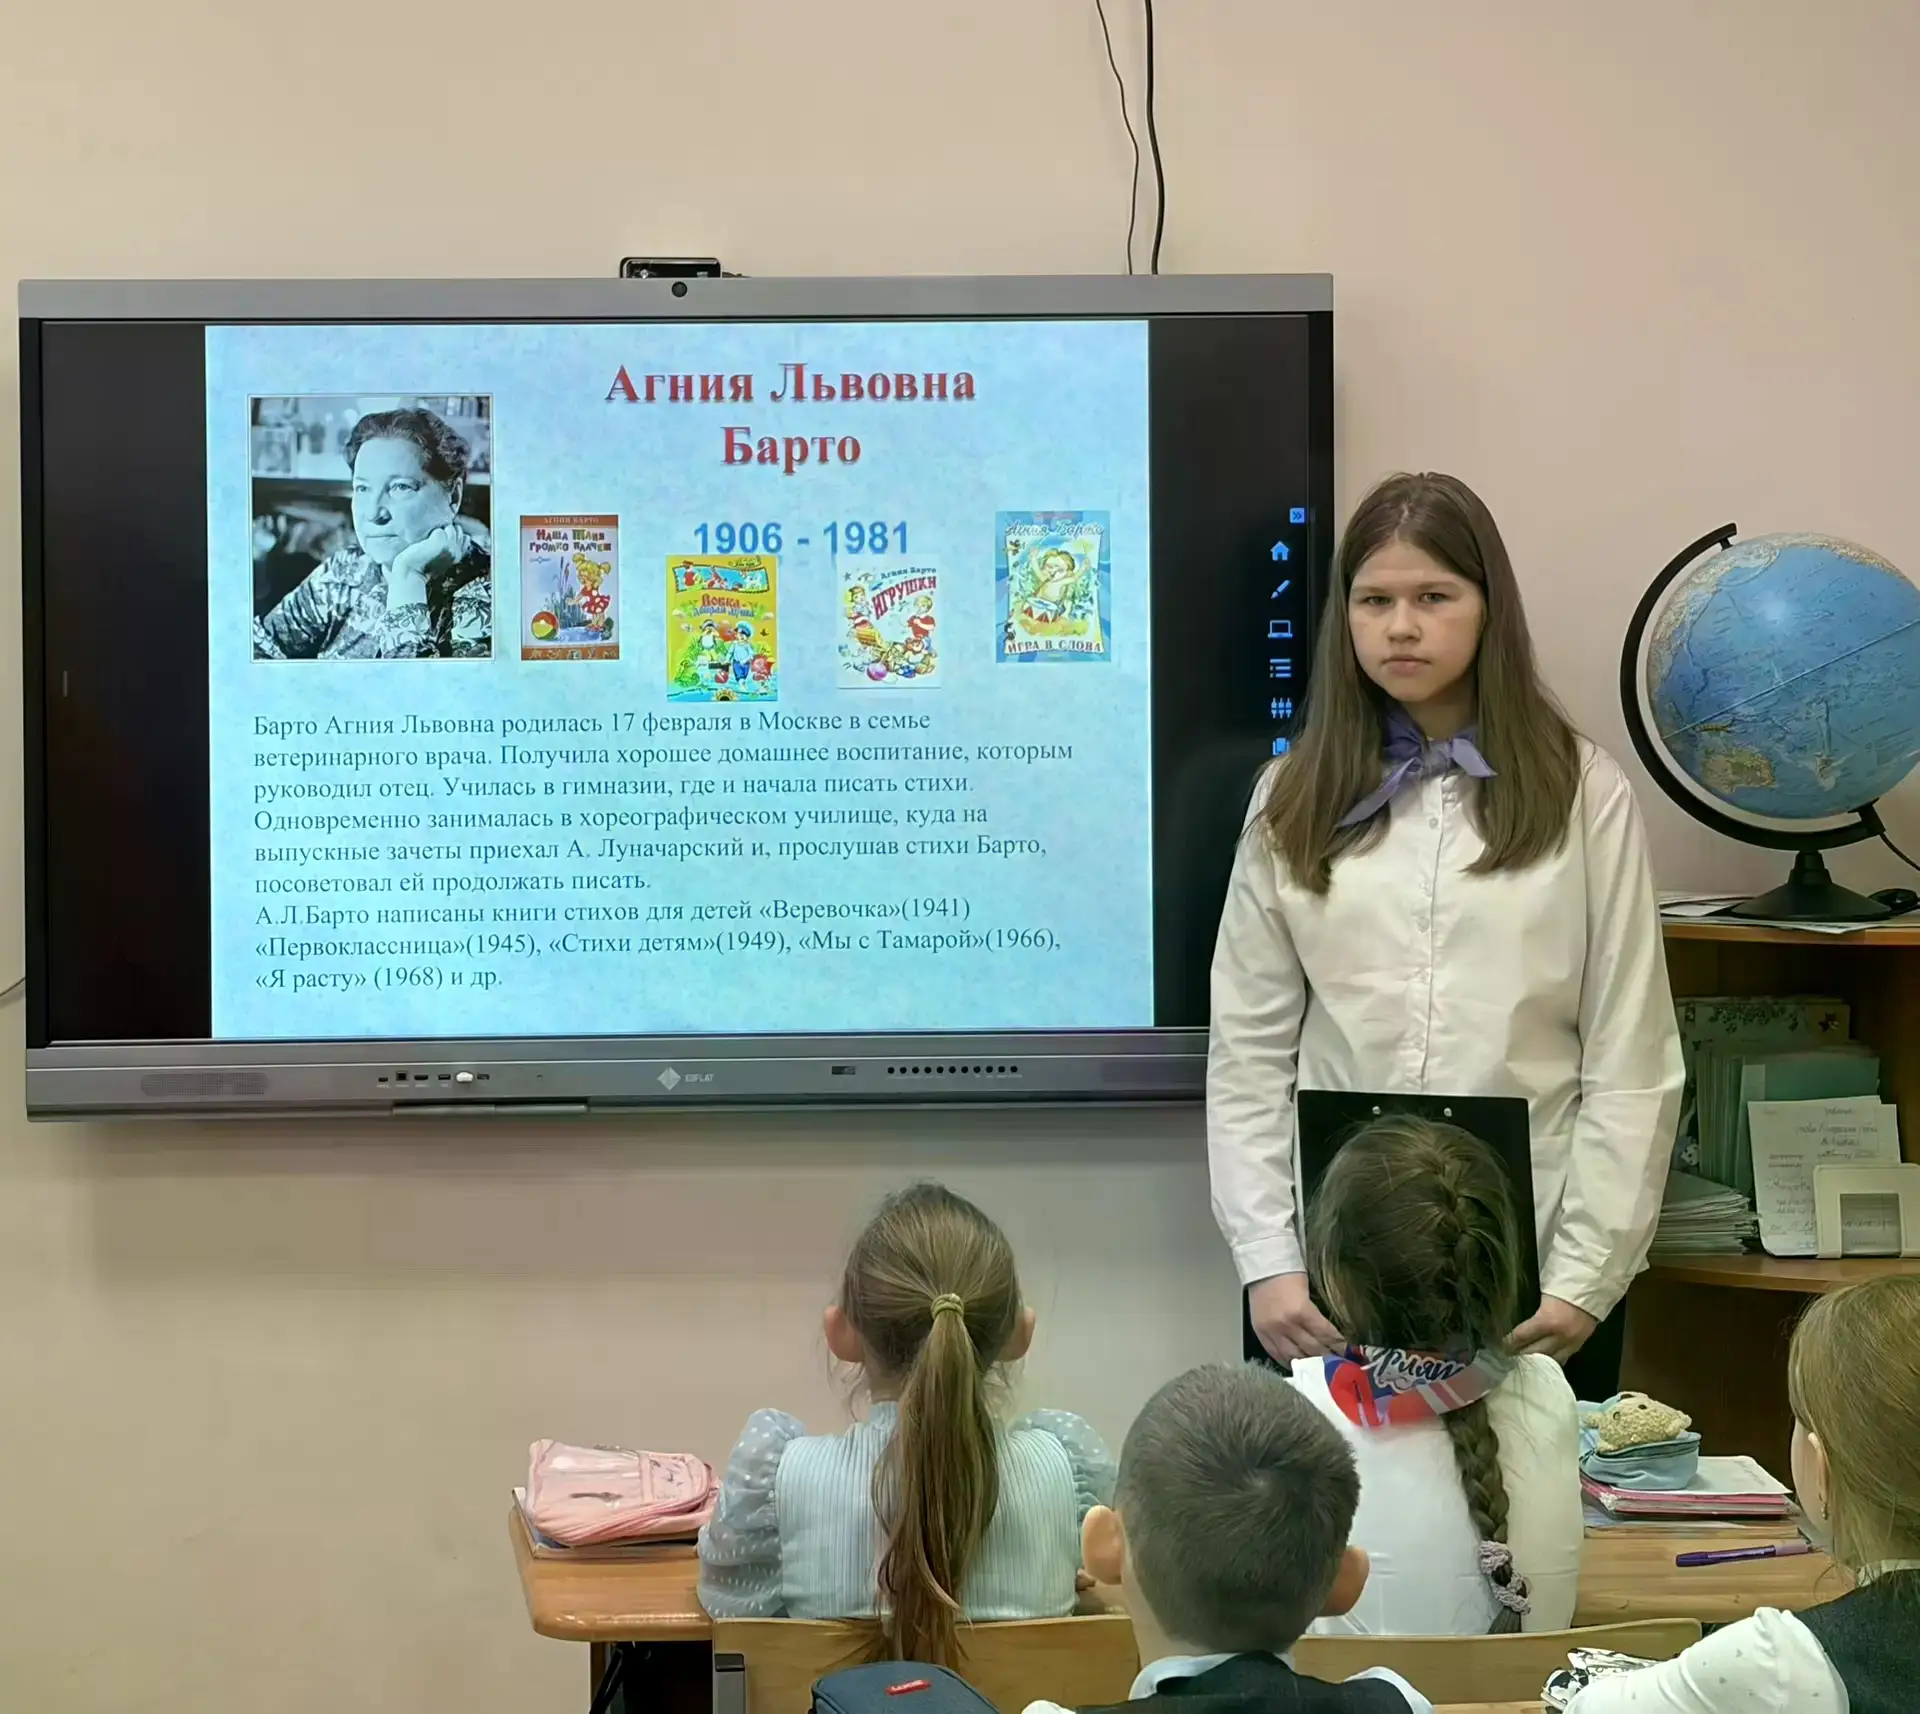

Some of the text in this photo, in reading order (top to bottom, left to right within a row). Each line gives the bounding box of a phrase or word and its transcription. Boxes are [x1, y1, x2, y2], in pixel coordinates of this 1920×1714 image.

[604, 362, 976, 403] Агния Львовна
[719, 425, 862, 476] Барто
[693, 521, 783, 554] 1906
[822, 520, 908, 555] 1981
[871, 575, 937, 621] ИГРУШКИ
[253, 711, 930, 741] Барто Агния Львовна родилась 17 февраля в Москве в семье
[253, 744, 1072, 772] ветеринарного врача. Получила хорошее домашнее воспитание, которым
[253, 776, 973, 805] руководил отец. Училась в гимназии, где и начала писать стихи.
[254, 805, 987, 835] Одновременно занималась в хореографическом училище, куда на
[255, 834, 1046, 867] выпускные зачеты приехал А. Луначарский и, прослушав стихи Барто,
[255, 872, 651, 897] посоветовал ей продолжать писать.
[255, 905, 369, 930] А.Л.Барто
[376, 908, 484, 924] написаны
[492, 907, 556, 922] книги
[564, 906, 638, 921] стихов
[645, 905, 683, 923] для
[690, 899, 752, 923] детей
[548, 932, 630, 953] «Стихи
[798, 930, 851, 950] «Мы
[858, 935, 869, 950] с
[255, 966, 502, 994] «Я расту» (1968) и др.
